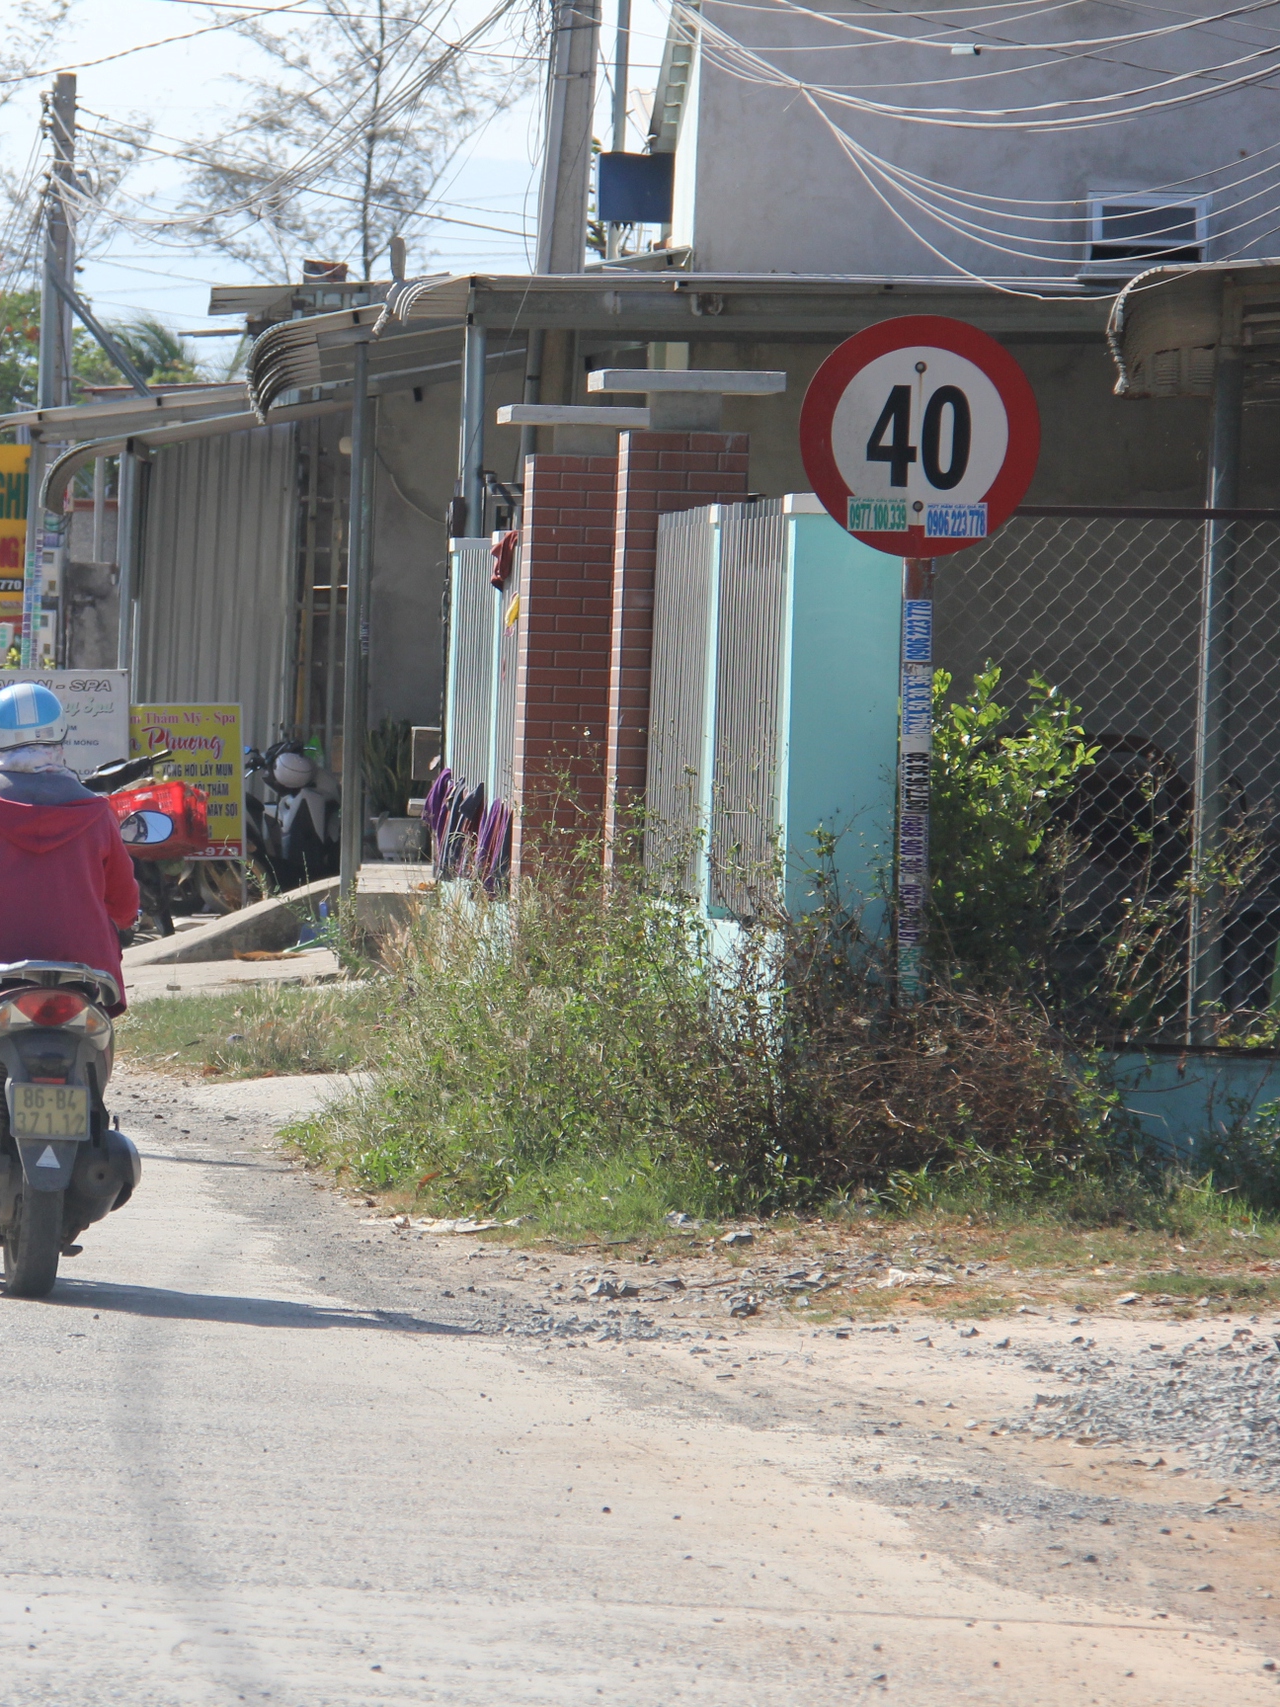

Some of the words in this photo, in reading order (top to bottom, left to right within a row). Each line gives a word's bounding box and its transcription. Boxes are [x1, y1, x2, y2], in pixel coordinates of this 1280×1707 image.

[866, 384, 971, 490] 40
[849, 503, 907, 530] 0977.100.339
[927, 509, 986, 536] 0906.223.778
[0, 580, 22, 591] 770
[69, 679, 112, 692] SPA
[213, 711, 236, 726] Spa
